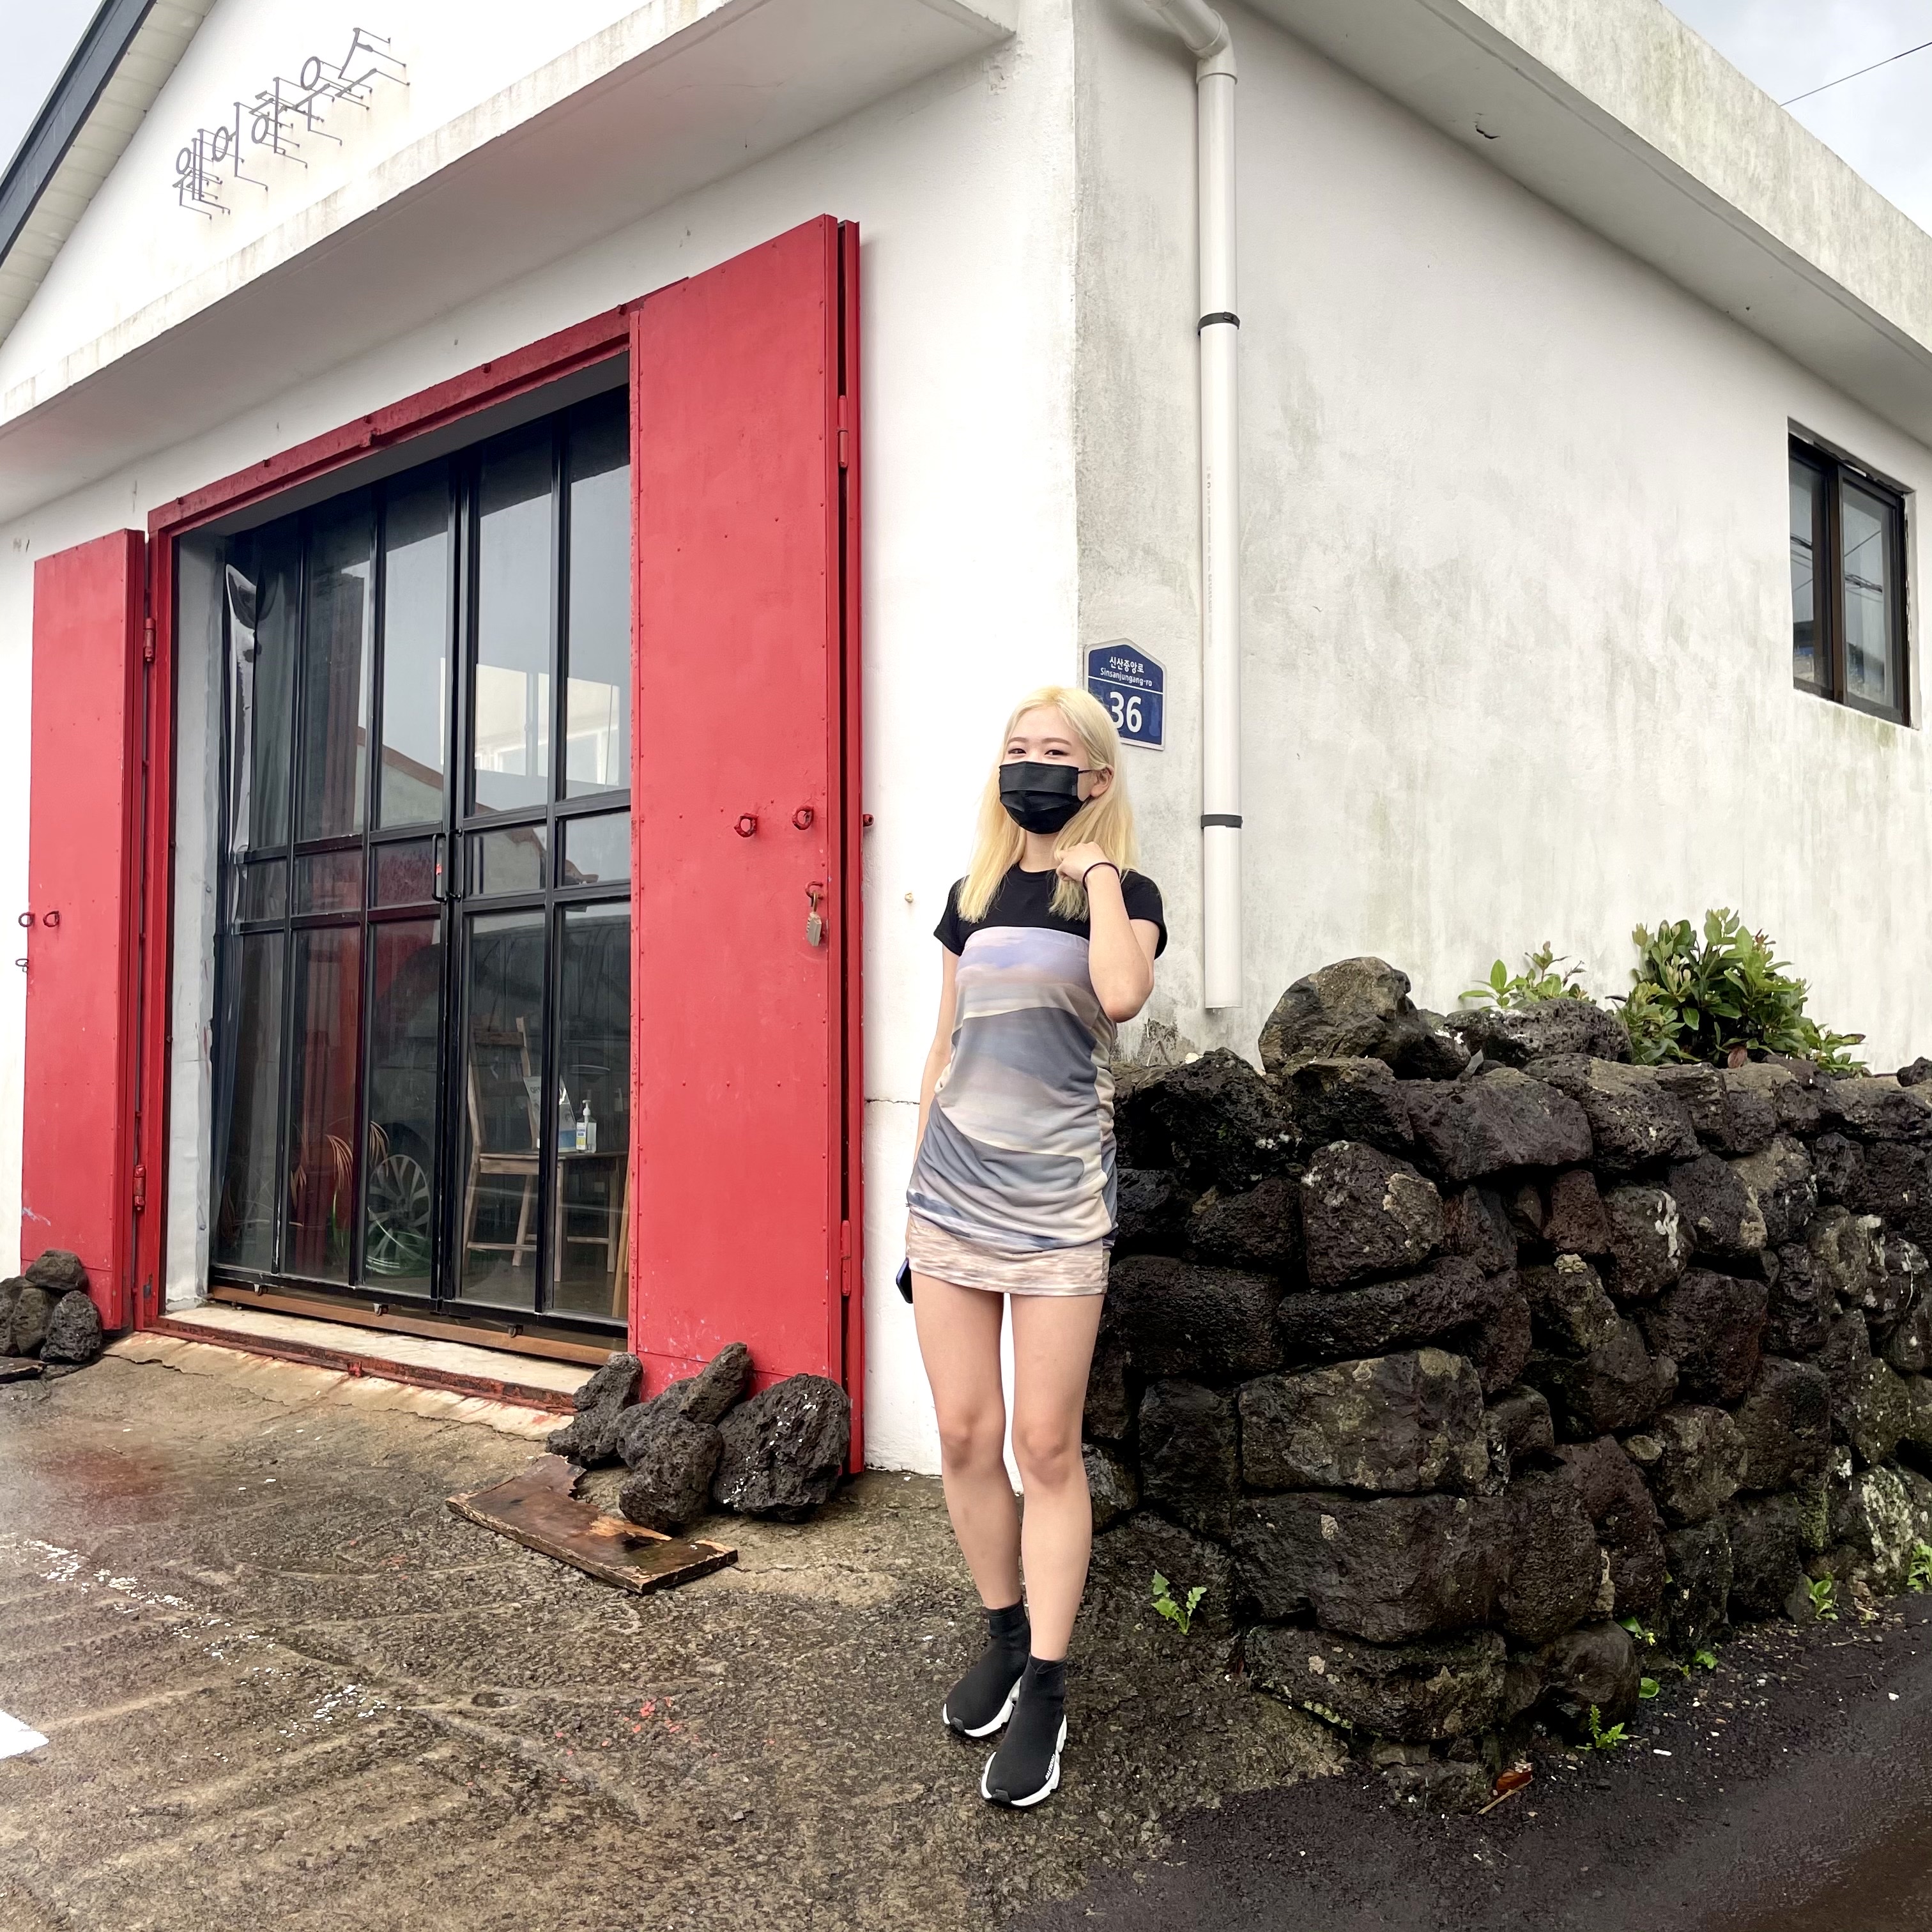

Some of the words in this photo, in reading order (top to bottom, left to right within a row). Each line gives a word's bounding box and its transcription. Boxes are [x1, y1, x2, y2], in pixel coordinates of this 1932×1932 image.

[1109, 656, 1145, 673] 신산중앙로
[1100, 667, 1153, 687] Sinsanjungang-ro
[1109, 691, 1142, 733] 36
